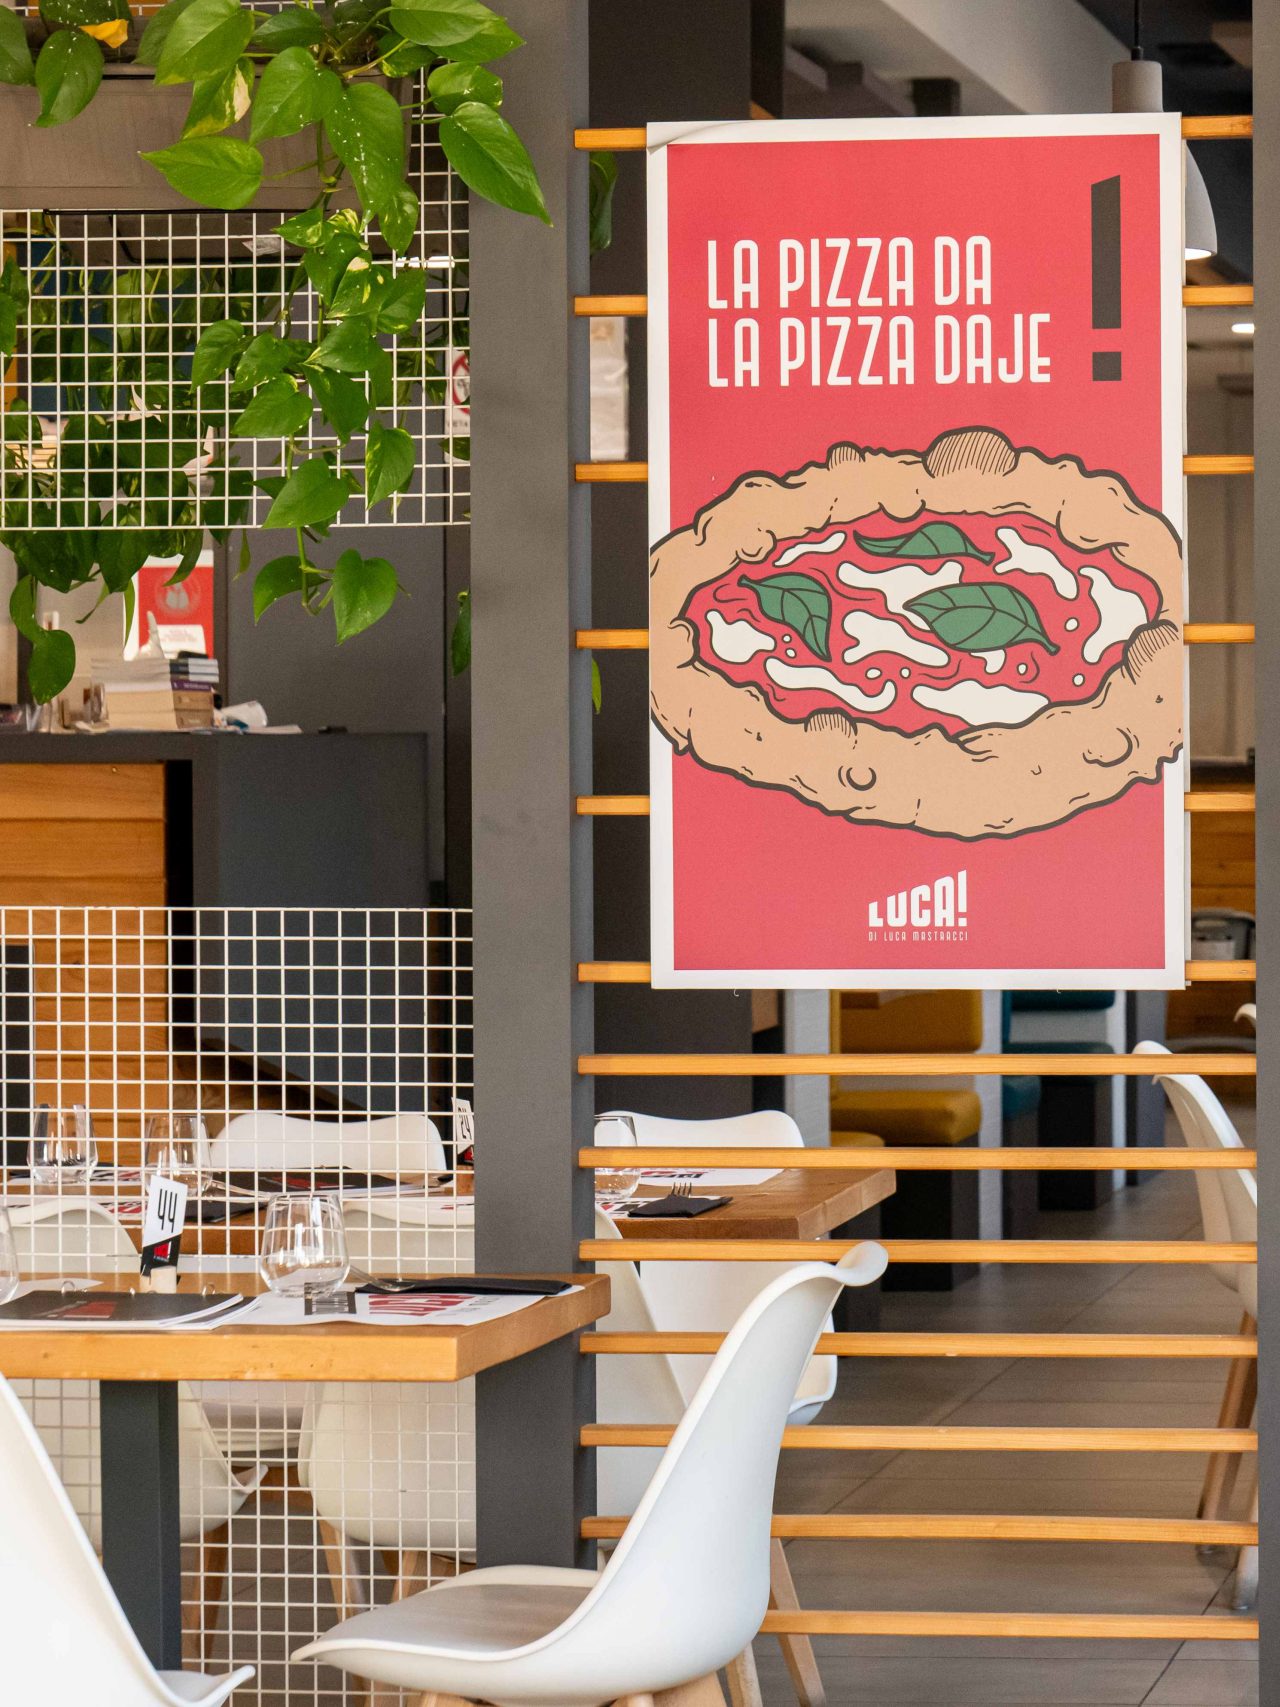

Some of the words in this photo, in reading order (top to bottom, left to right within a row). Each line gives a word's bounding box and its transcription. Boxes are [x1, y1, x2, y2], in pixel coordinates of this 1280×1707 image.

[707, 239, 759, 309] LA
[779, 236, 914, 308] PIZZA
[934, 235, 992, 306] DA
[708, 317, 760, 388] LA
[780, 315, 915, 387] PIZZA
[934, 313, 1051, 384] DAJE
[868, 869, 967, 927] LUCA!
[868, 931, 877, 941] DI
[884, 931, 907, 941] LUCA
[157, 1188, 178, 1233] 44
